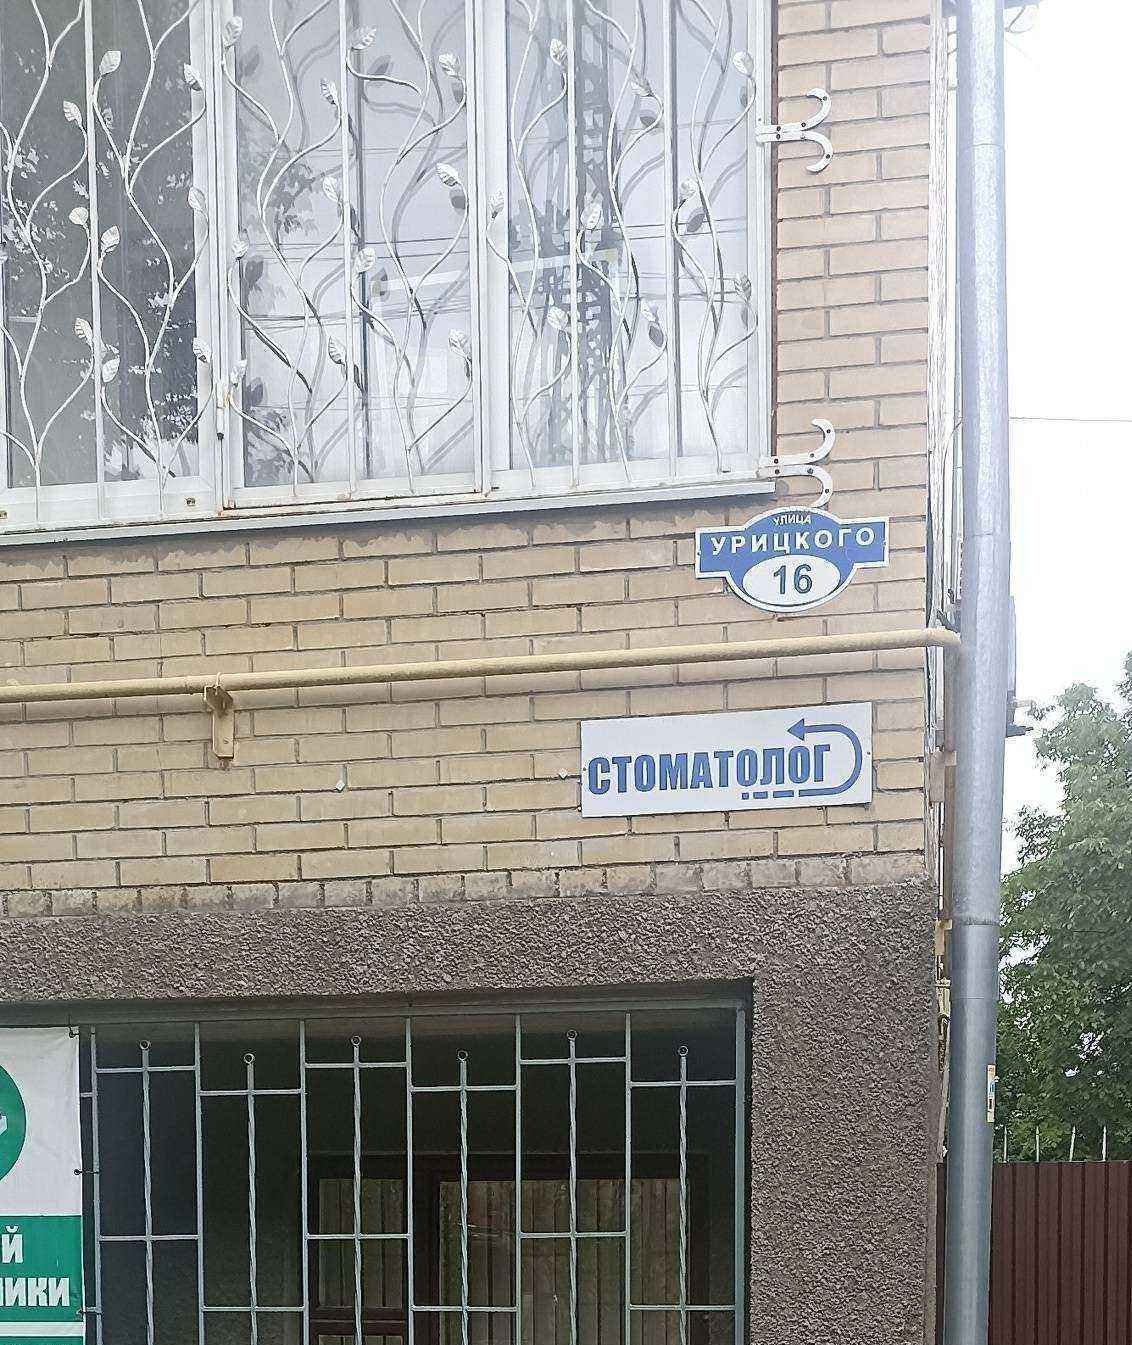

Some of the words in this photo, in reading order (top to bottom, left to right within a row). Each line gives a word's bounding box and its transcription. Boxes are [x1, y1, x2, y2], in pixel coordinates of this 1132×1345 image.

[773, 514, 812, 526] УЛИЦА
[710, 527, 876, 555] УРИЦКОГО
[773, 563, 813, 595] 16
[587, 743, 831, 795] СТОМАТОЛОГ
[0, 1277, 70, 1307] ИКИ
